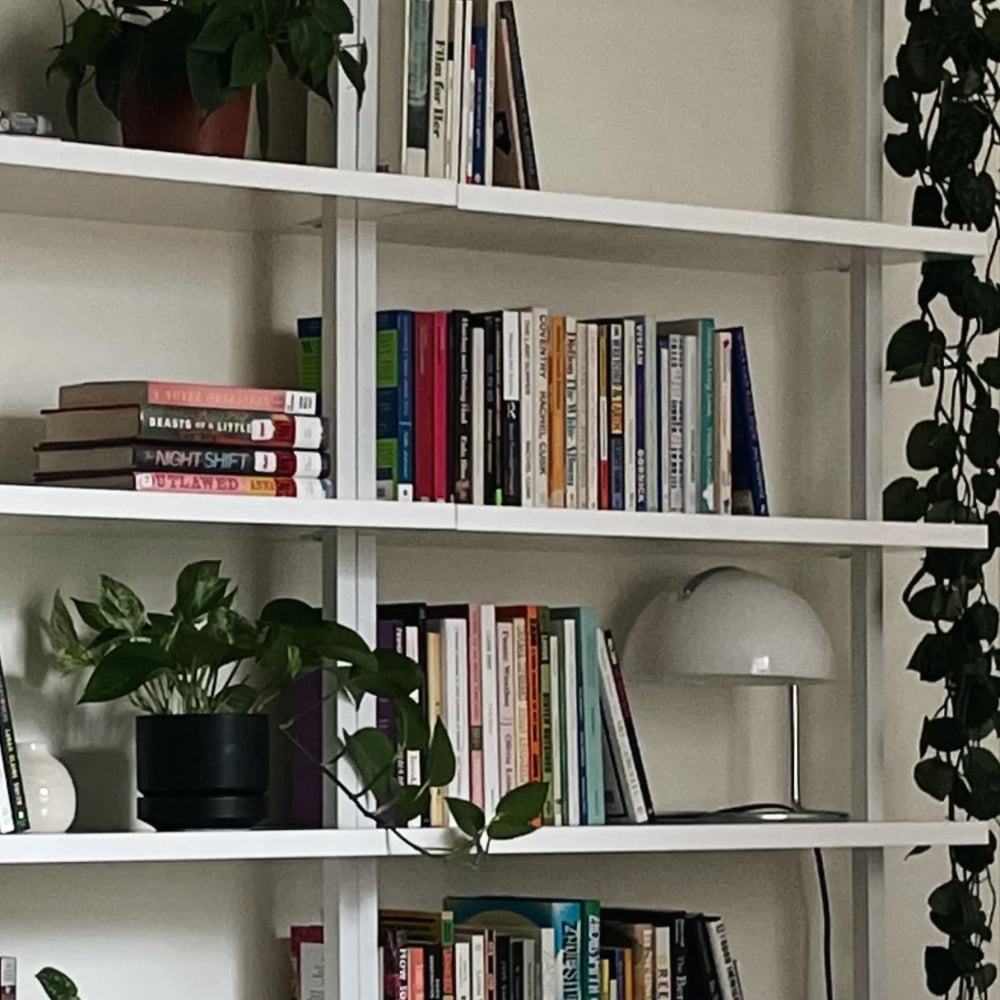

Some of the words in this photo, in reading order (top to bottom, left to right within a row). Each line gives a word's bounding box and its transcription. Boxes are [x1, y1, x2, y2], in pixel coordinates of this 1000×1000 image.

[435, 40, 445, 77] Film
[433, 81, 444, 103] for
[433, 109, 444, 139] Her
[539, 314, 548, 379] COVENTRY
[636, 324, 644, 366] VIVIAN
[149, 416, 192, 430] BEASTS
[539, 390, 548, 439] RACHEL
[154, 450, 201, 468] NIGHT
[204, 452, 250, 470] SHIFT
[539, 442, 548, 476] CUSK
[151, 472, 239, 491] UTLAWED
[398, 948, 410, 980] How
